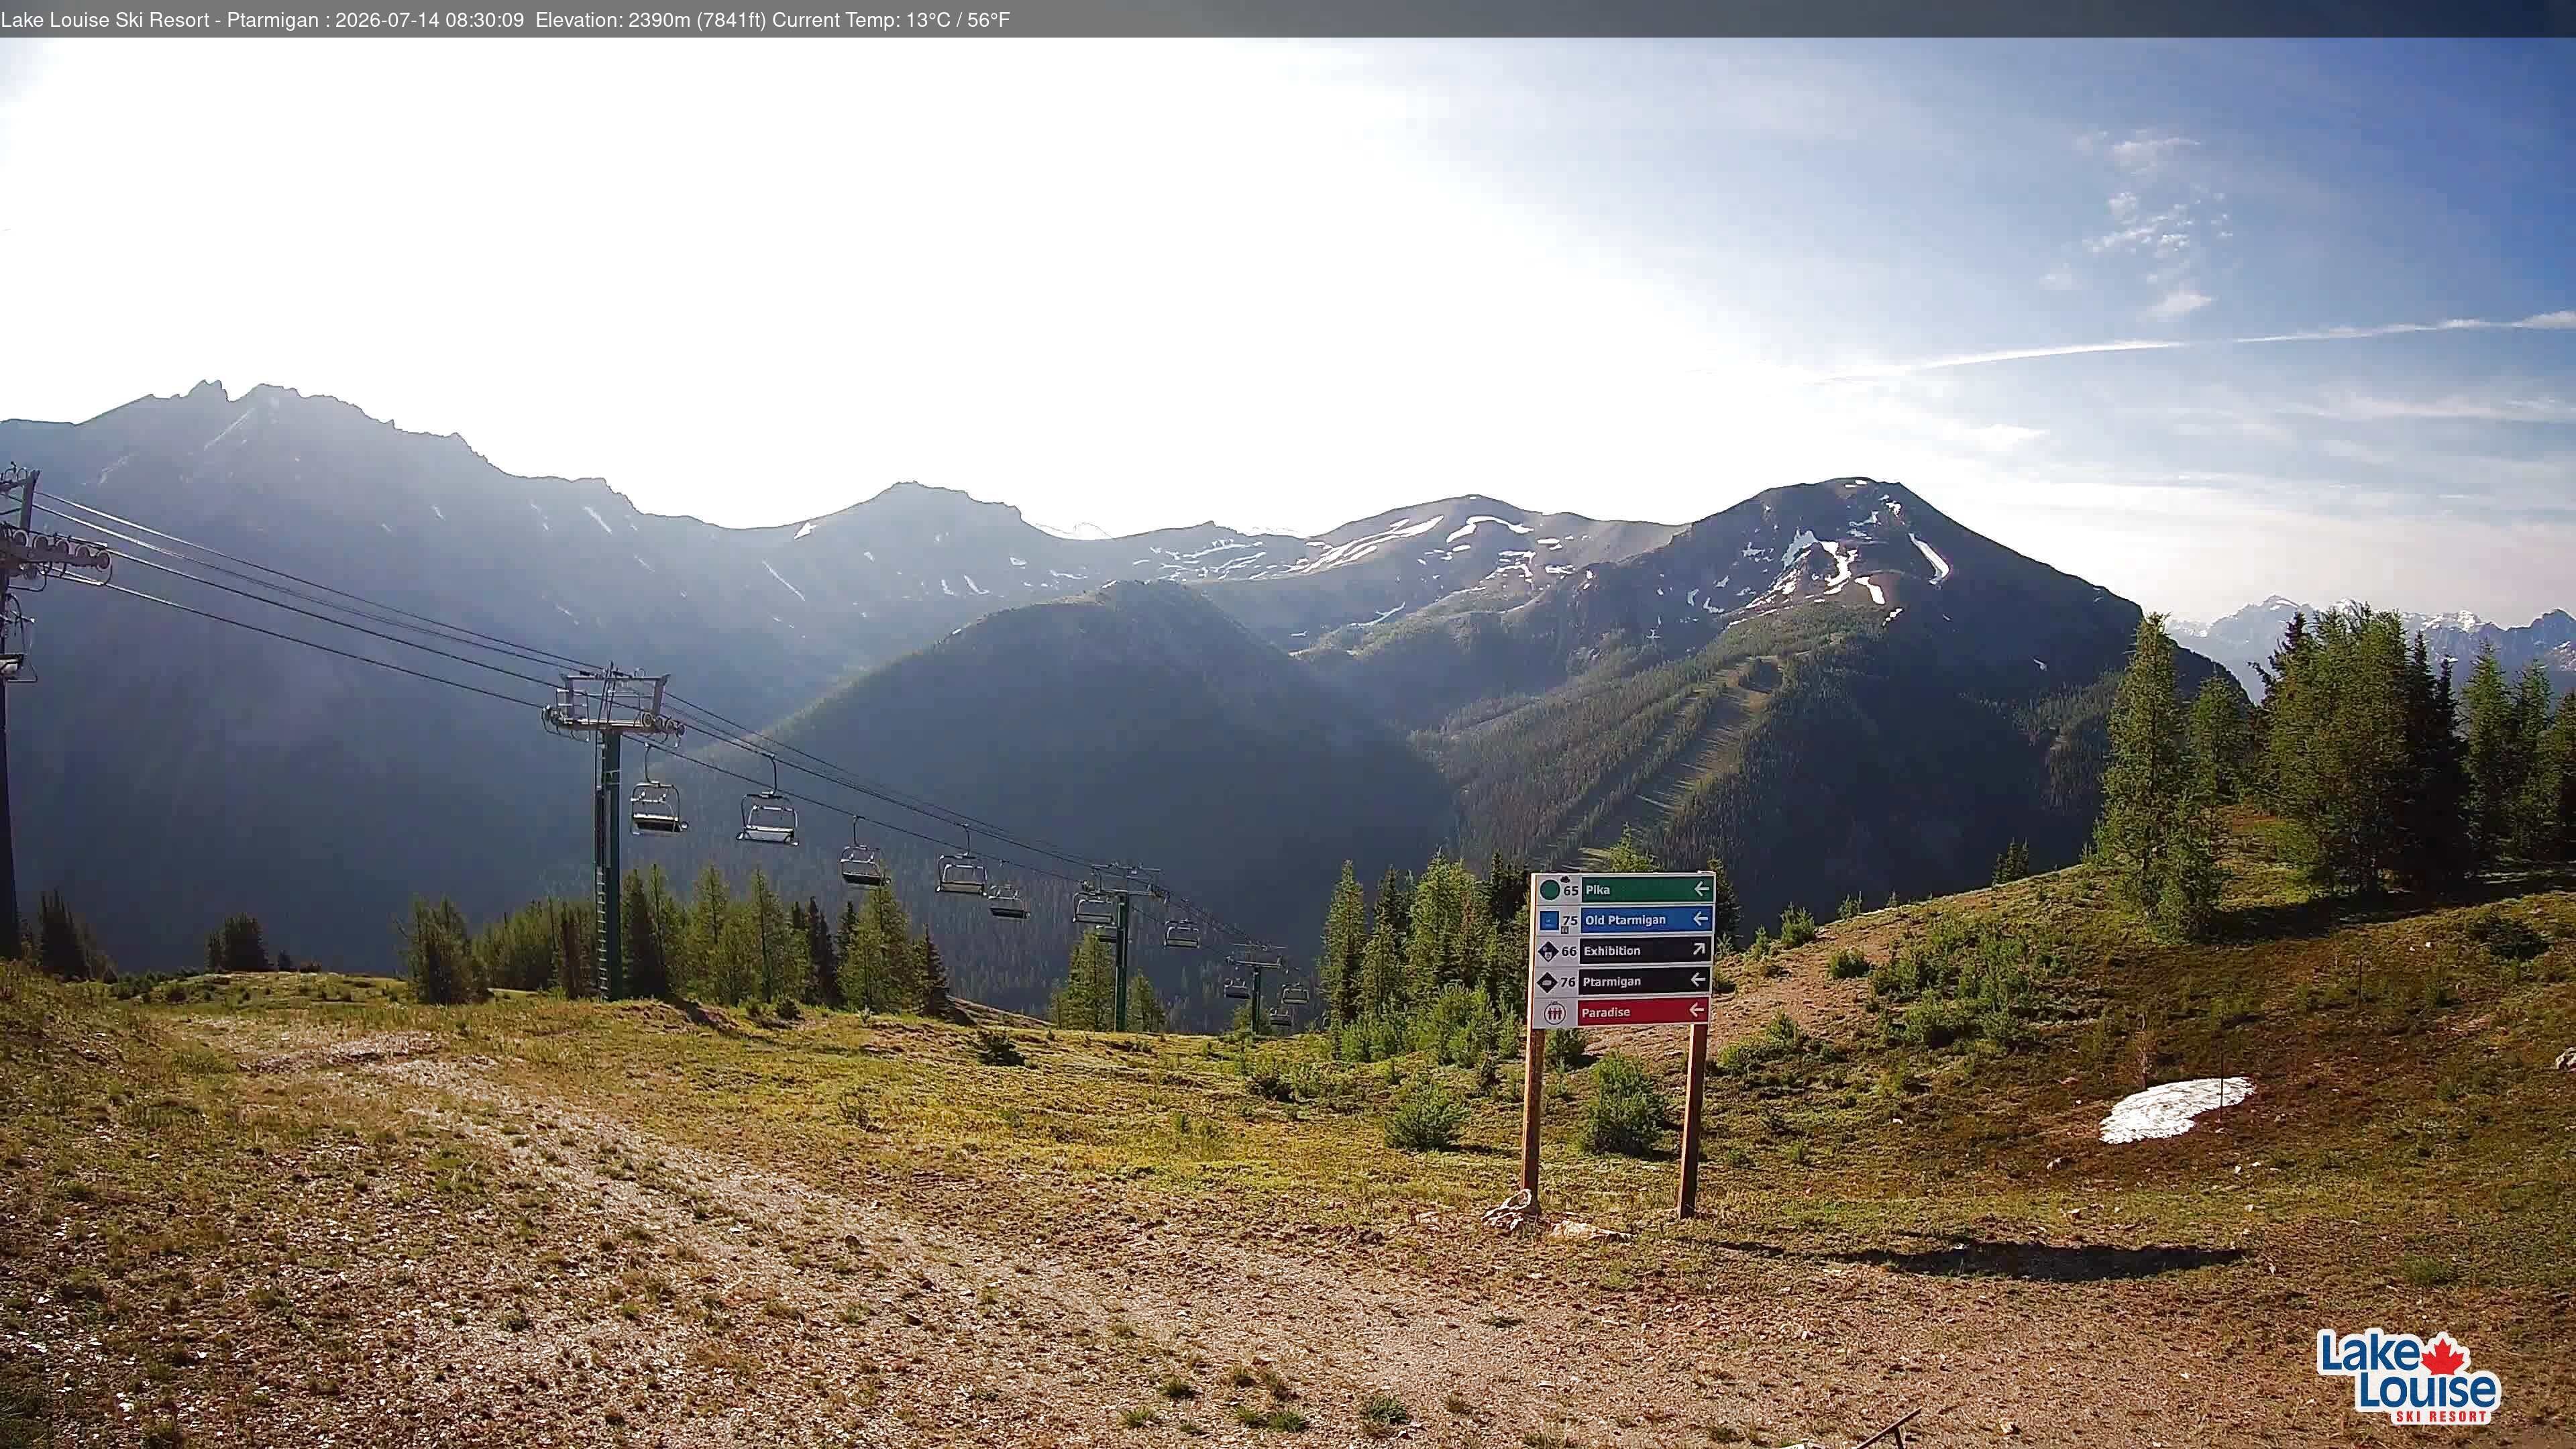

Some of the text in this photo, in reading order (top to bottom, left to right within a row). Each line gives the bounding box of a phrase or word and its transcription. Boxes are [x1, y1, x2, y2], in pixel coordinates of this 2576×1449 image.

[1563, 884, 1611, 896] 65 Pika
[1562, 914, 1666, 926] 75 Old Ptarmigan
[1561, 945, 1641, 957] 66 Exhibition
[1560, 976, 1642, 988] 76 Ptarmigan
[1582, 1007, 1631, 1018] Paradise
